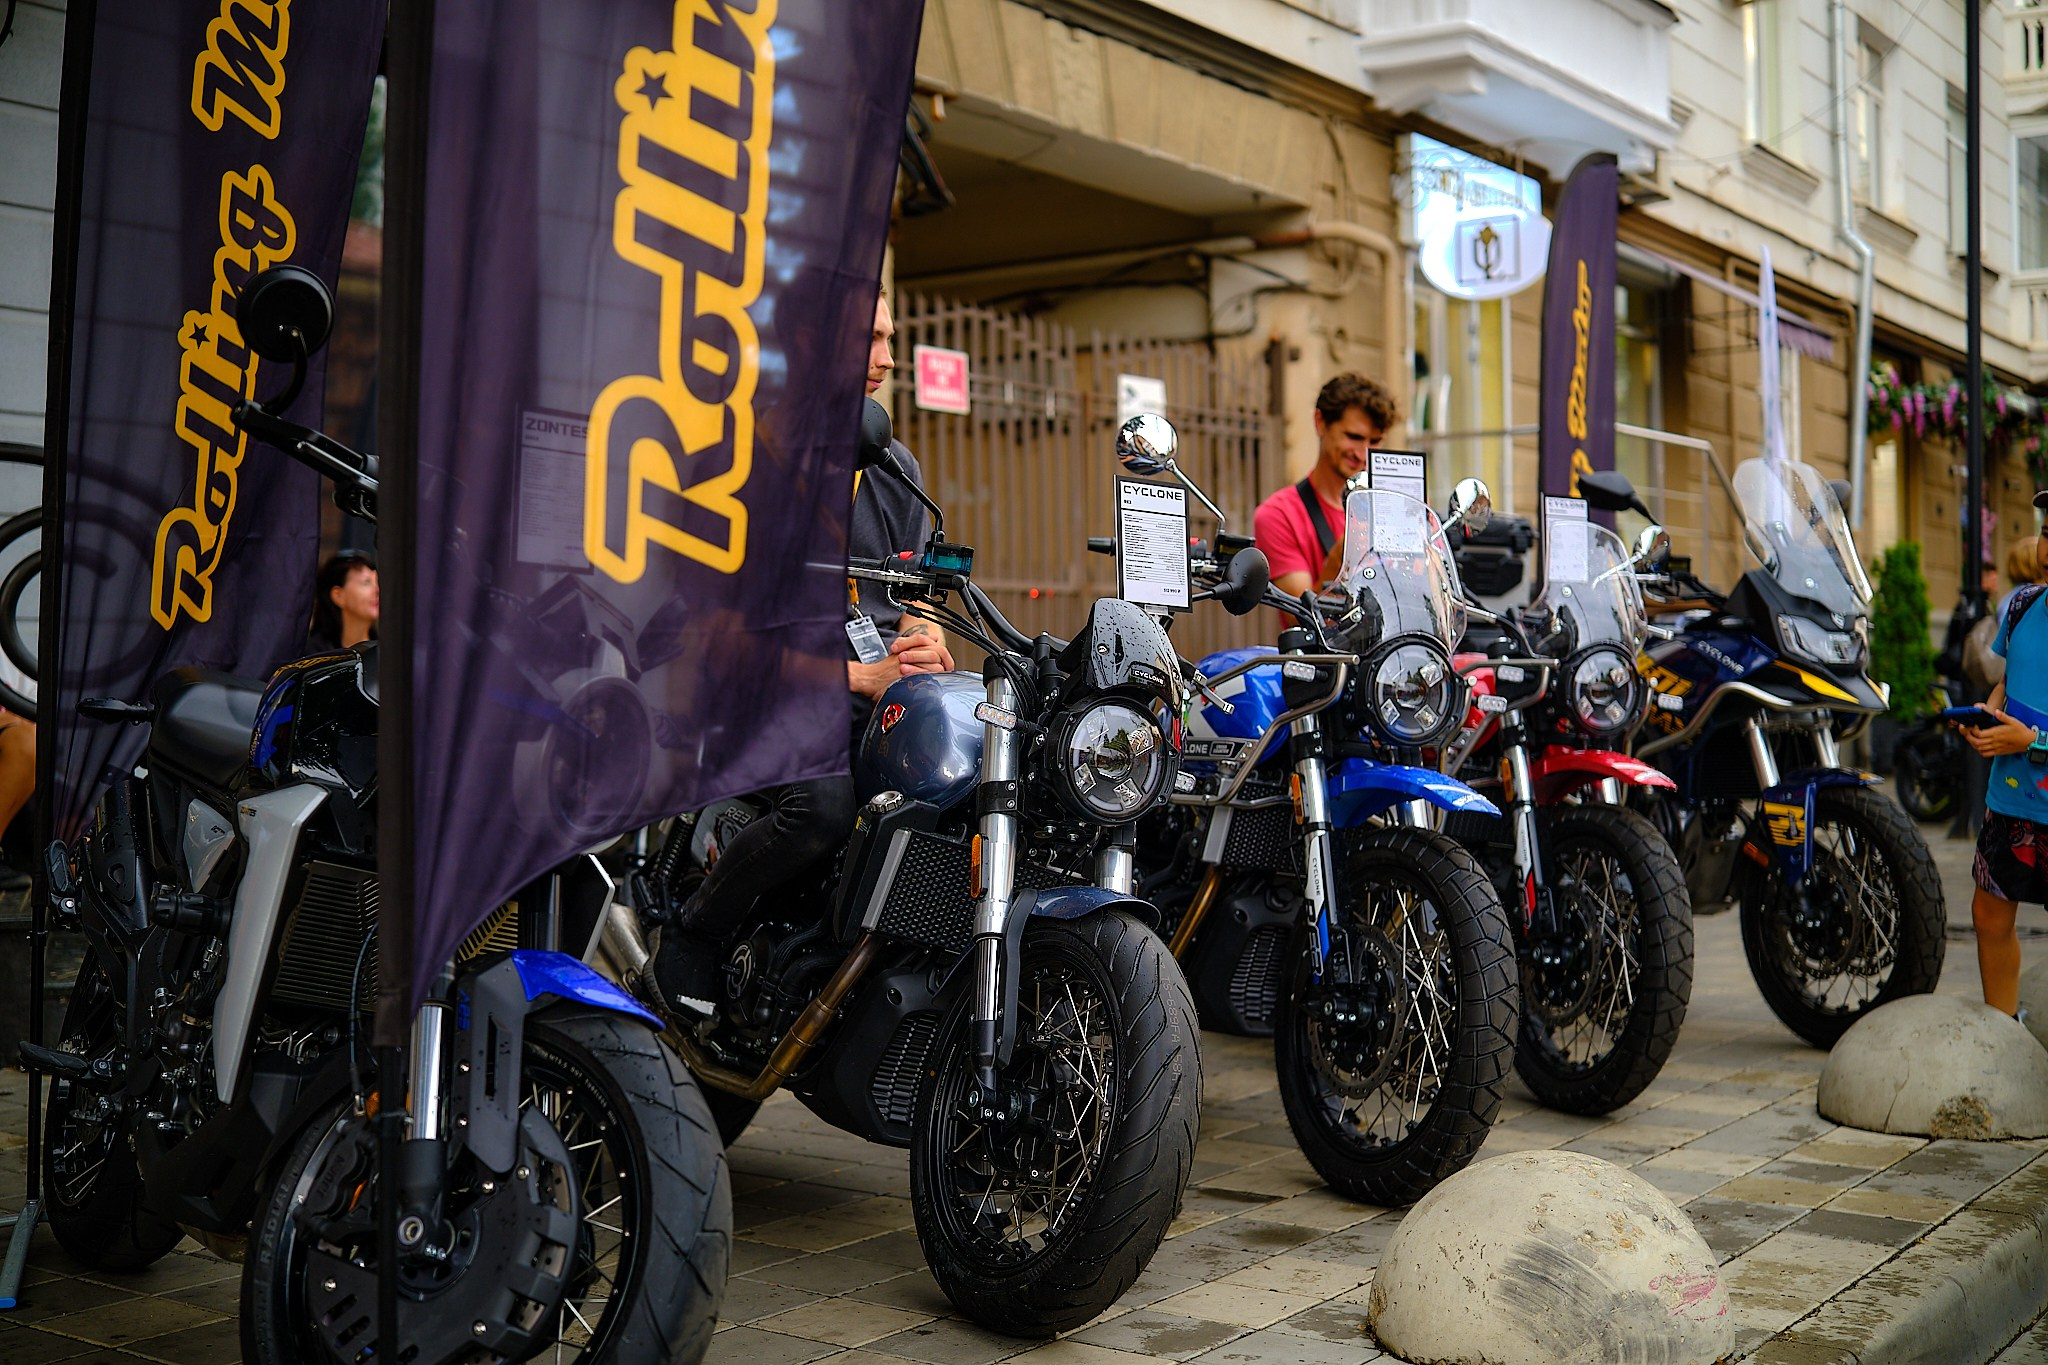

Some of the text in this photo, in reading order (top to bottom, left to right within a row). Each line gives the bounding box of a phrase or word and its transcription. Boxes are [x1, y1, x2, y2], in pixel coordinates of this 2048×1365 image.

[525, 417, 590, 439] ZONTES
[1374, 455, 1421, 467] CYCLONE
[1124, 485, 1182, 501] CYCLONE
[1698, 640, 1745, 675] CYCLONE
[1134, 670, 1164, 685] CYCLONE
[724, 806, 751, 824] RE3
[1312, 857, 1320, 896] CYCLONE
[260, 1183, 292, 1264] RADIAL
